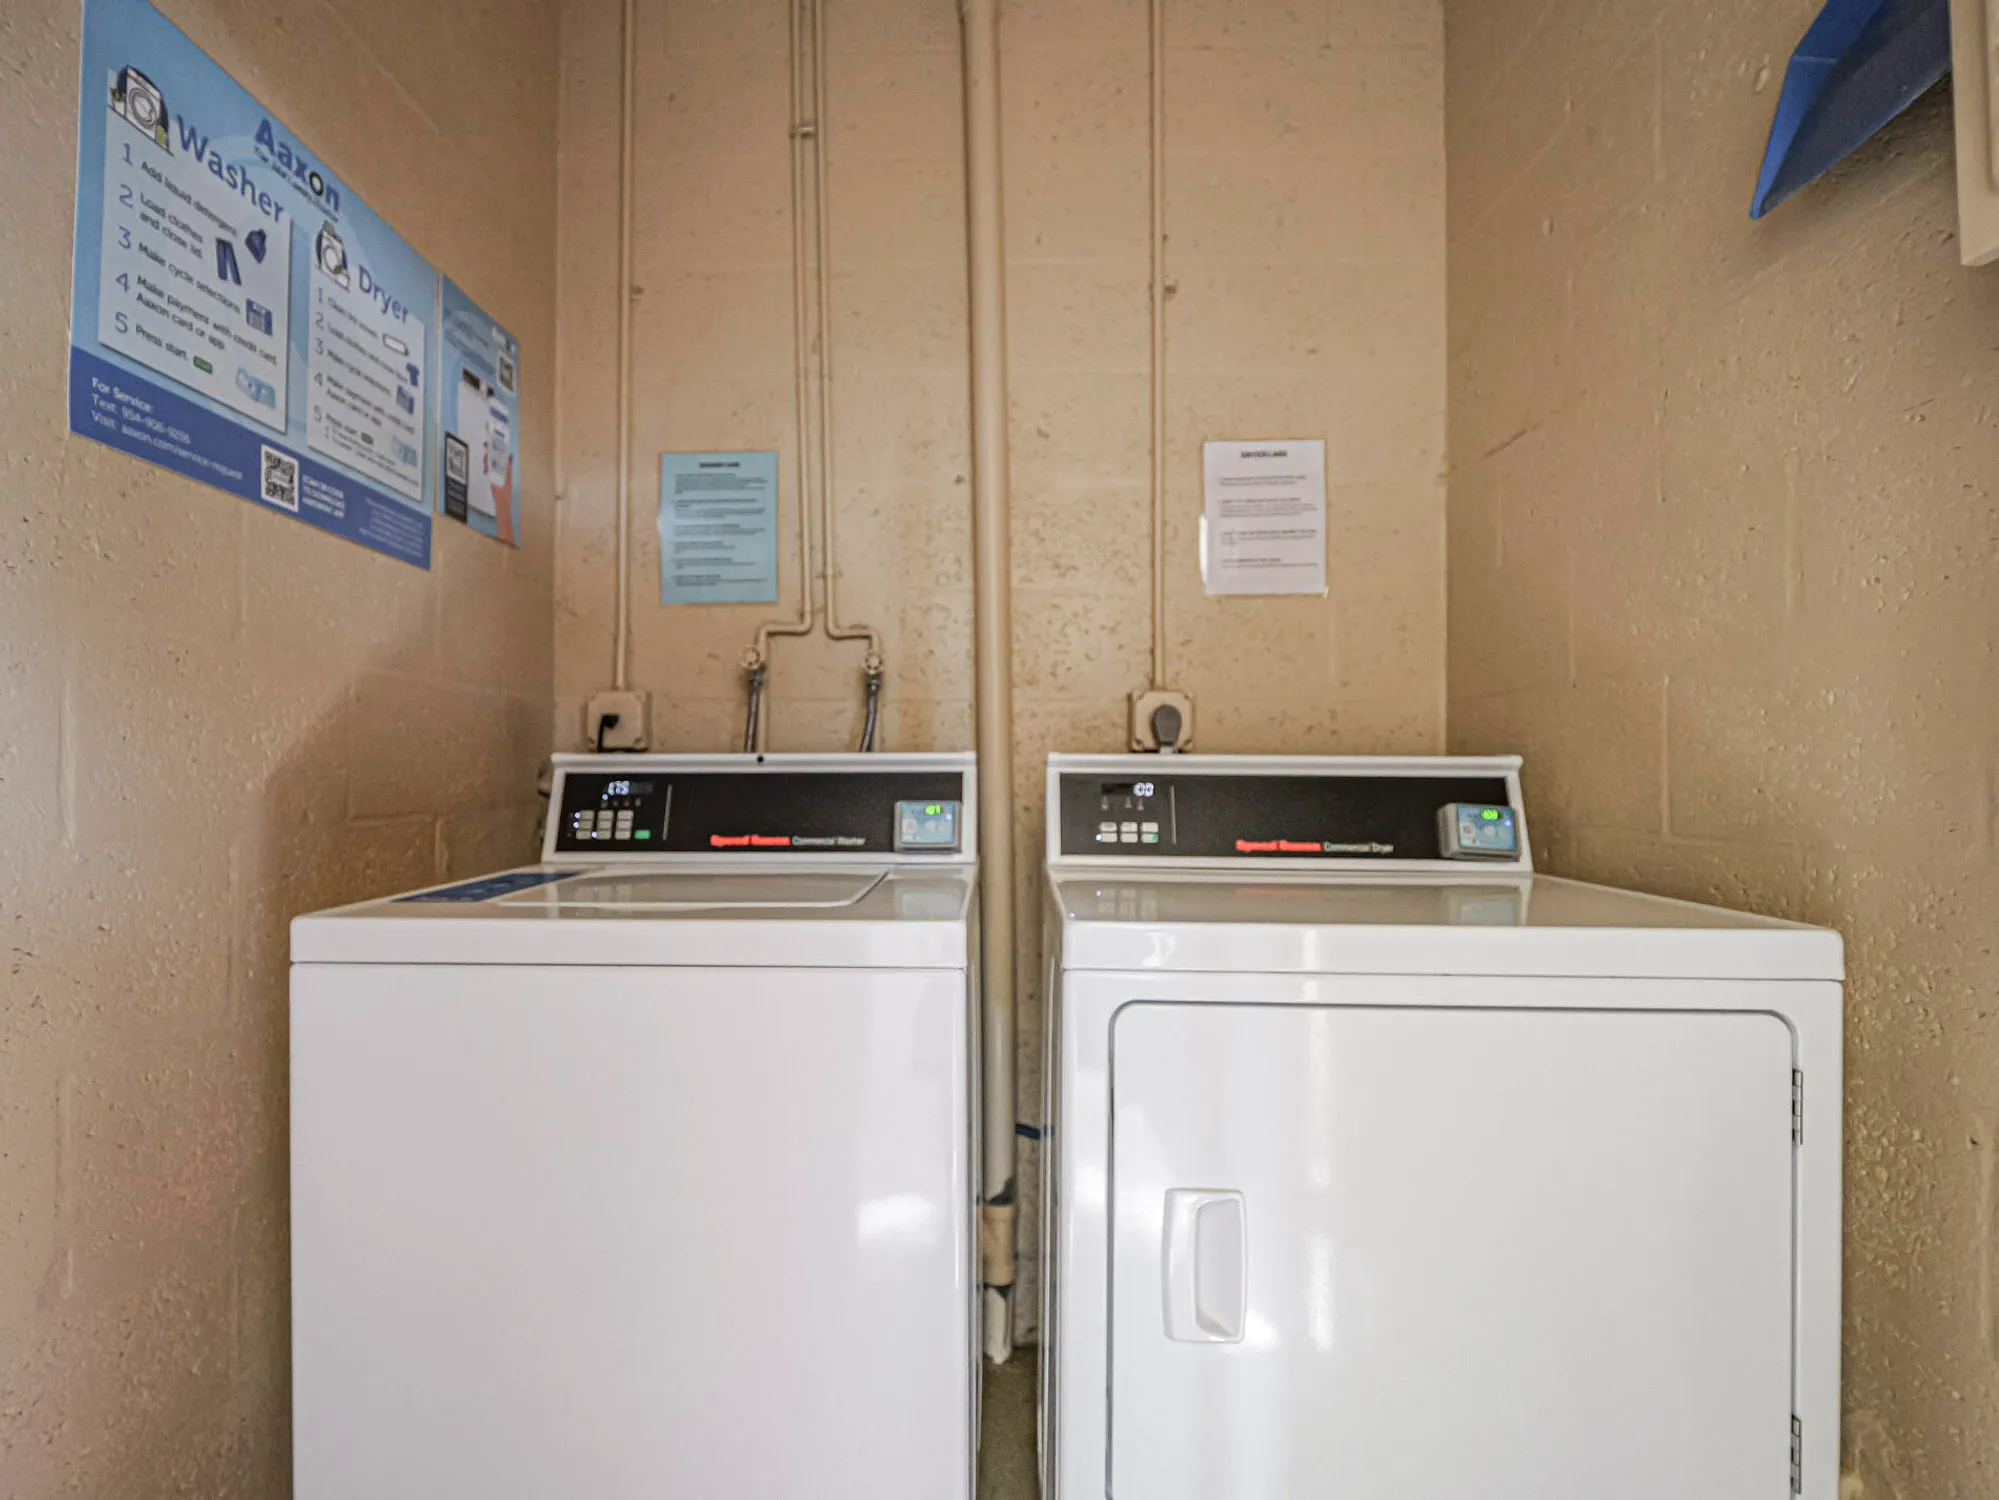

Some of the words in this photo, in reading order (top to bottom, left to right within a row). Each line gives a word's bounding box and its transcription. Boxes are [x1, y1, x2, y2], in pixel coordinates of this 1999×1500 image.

[123, 143, 133, 167] 1
[254, 118, 341, 213] Aaxon
[176, 114, 284, 223] Washer
[118, 184, 134, 209] 2
[118, 225, 131, 250] 3
[116, 272, 130, 292] 4
[359, 264, 409, 324] Dryer
[115, 311, 129, 333] 5
